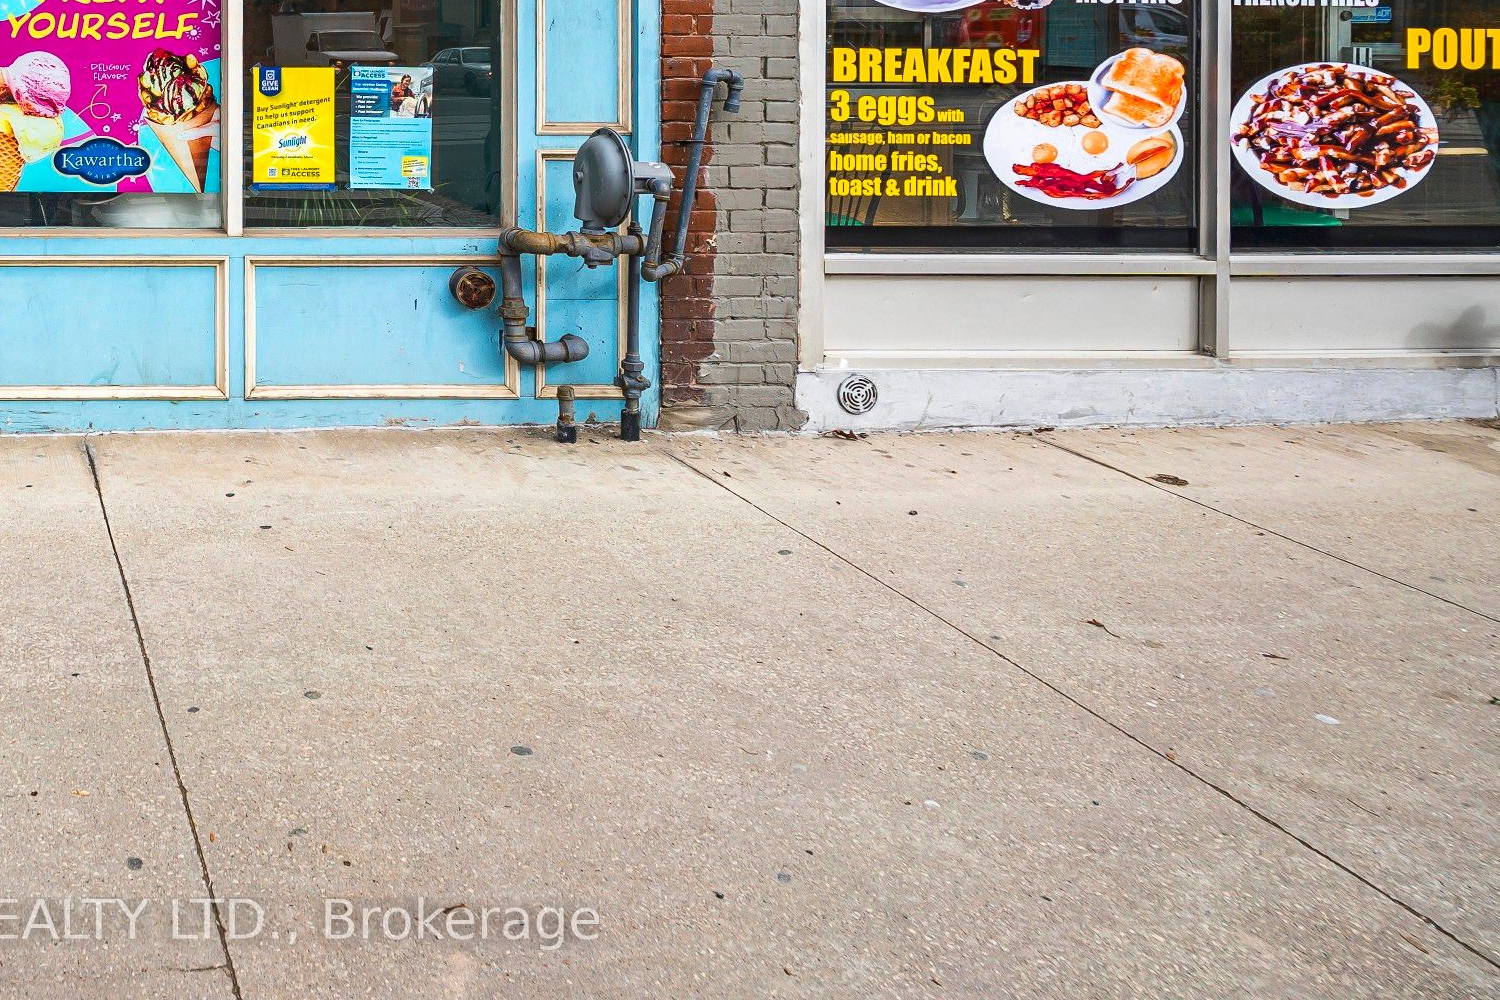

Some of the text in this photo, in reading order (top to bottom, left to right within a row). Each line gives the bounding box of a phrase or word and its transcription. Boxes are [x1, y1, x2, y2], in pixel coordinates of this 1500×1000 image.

[8, 12, 199, 41] YOURSELF
[90, 63, 132, 72] DELICIOUS
[833, 47, 1040, 84] BREAKFAST
[93, 72, 129, 81] FLAVORS
[299, 97, 331, 106] detergent
[830, 89, 965, 126] 3 eggs with
[265, 112, 279, 120] help
[289, 107, 315, 116] support
[256, 119, 290, 130] Canadians
[278, 135, 307, 149] Sunlight
[829, 131, 972, 146] sausage, ham or bacon
[61, 153, 144, 170] Kawartha
[830, 150, 943, 174] home fries,
[87, 170, 117, 180] DAIRY
[829, 175, 958, 197] toast & drink
